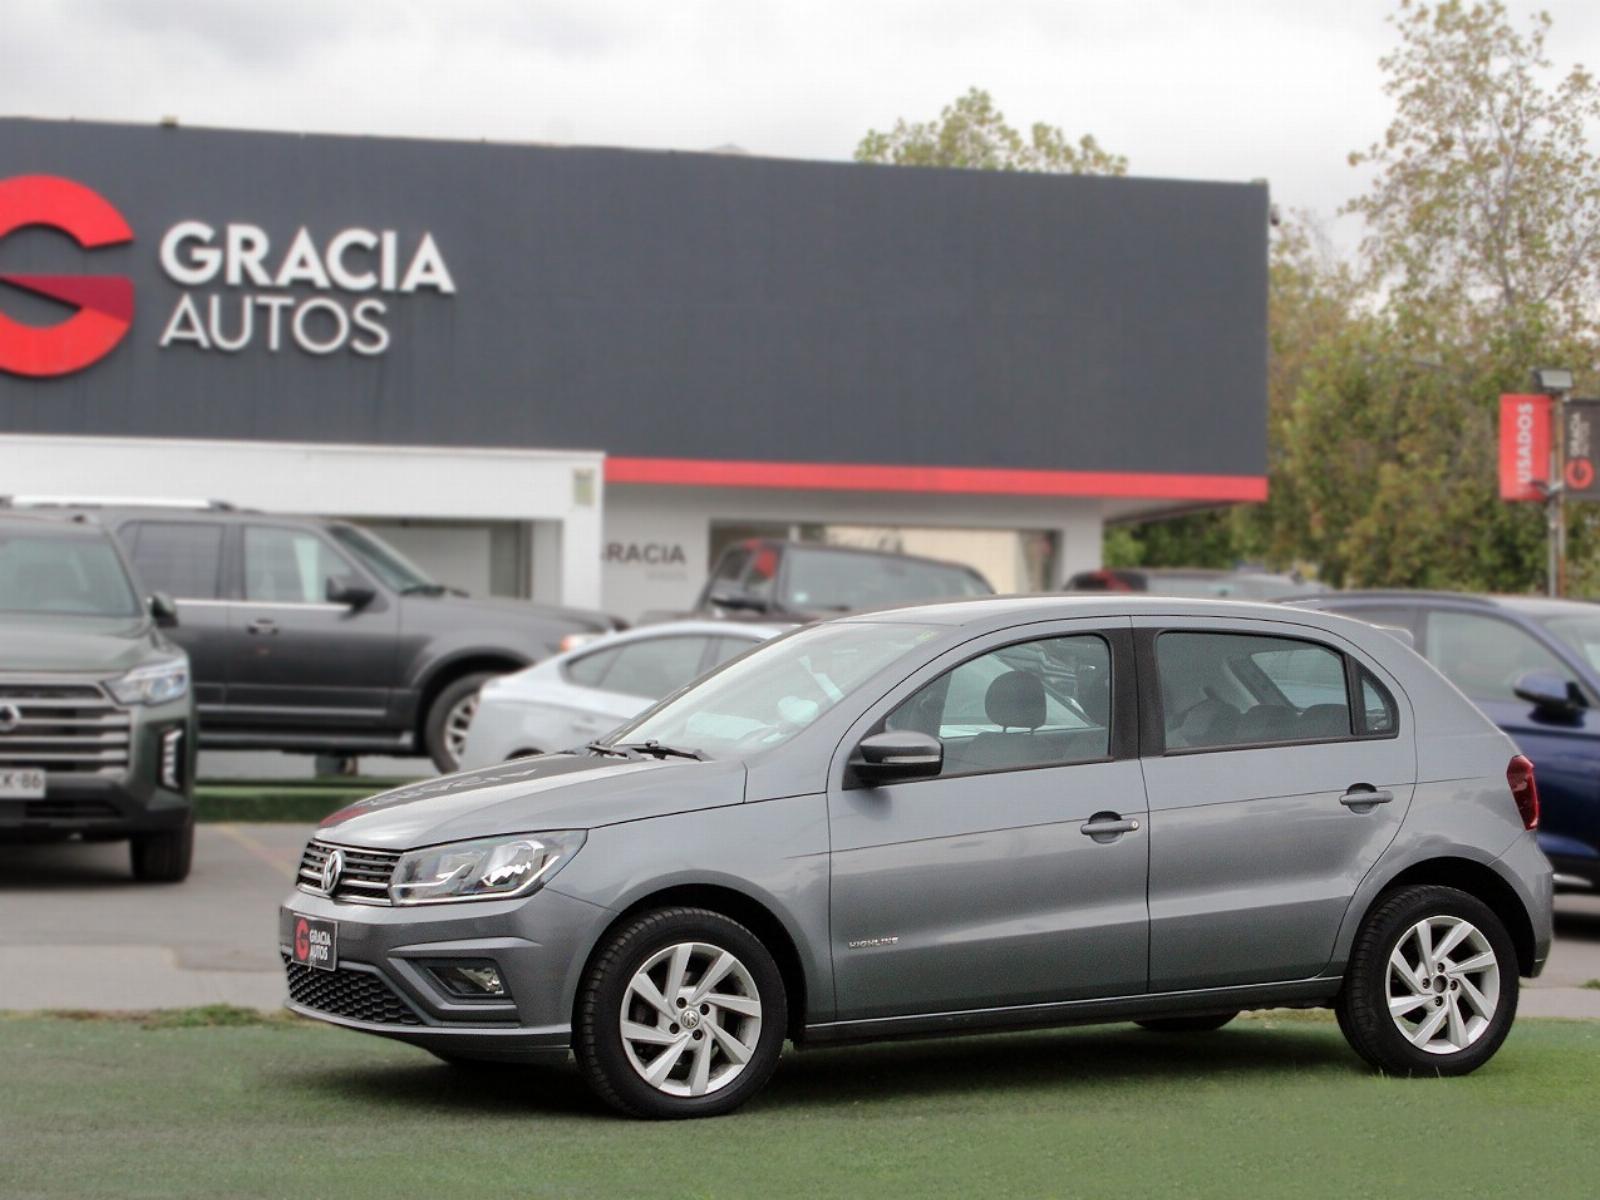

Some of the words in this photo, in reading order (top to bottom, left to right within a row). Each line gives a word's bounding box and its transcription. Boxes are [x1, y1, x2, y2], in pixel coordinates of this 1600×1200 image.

[160, 221, 456, 294] GRACIA
[160, 293, 391, 355] AUTOS
[1516, 403, 1533, 483] USADOS
[600, 542, 687, 564] RACIA
